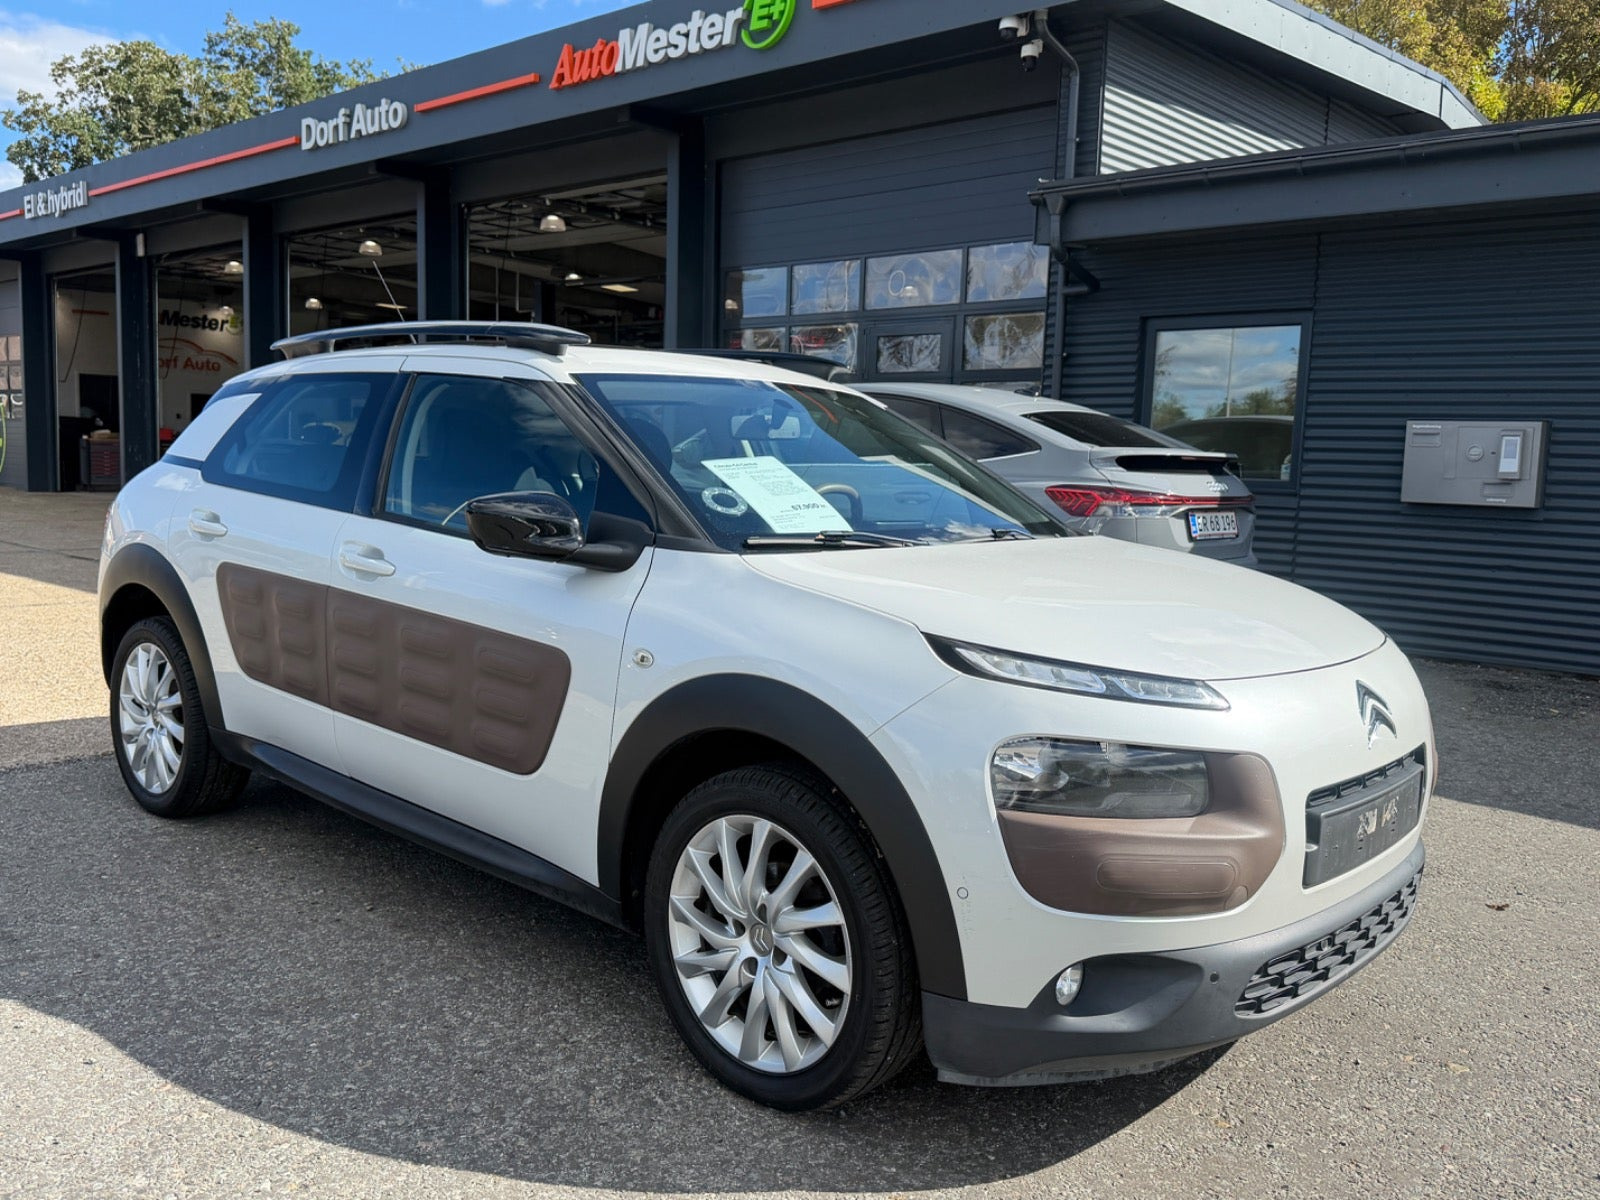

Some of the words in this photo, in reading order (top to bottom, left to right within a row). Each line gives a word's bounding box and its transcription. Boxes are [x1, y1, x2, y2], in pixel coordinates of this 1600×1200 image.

[549, 6, 744, 90] AutoMester
[301, 107, 350, 151] Dorf
[350, 97, 408, 139] Auto
[23, 193, 36, 219] El
[47, 181, 88, 218] hybrid
[159, 310, 229, 332] Mester
[158, 355, 179, 369] orf
[183, 356, 221, 371] Auto
[1210, 515, 1221, 531] 68
